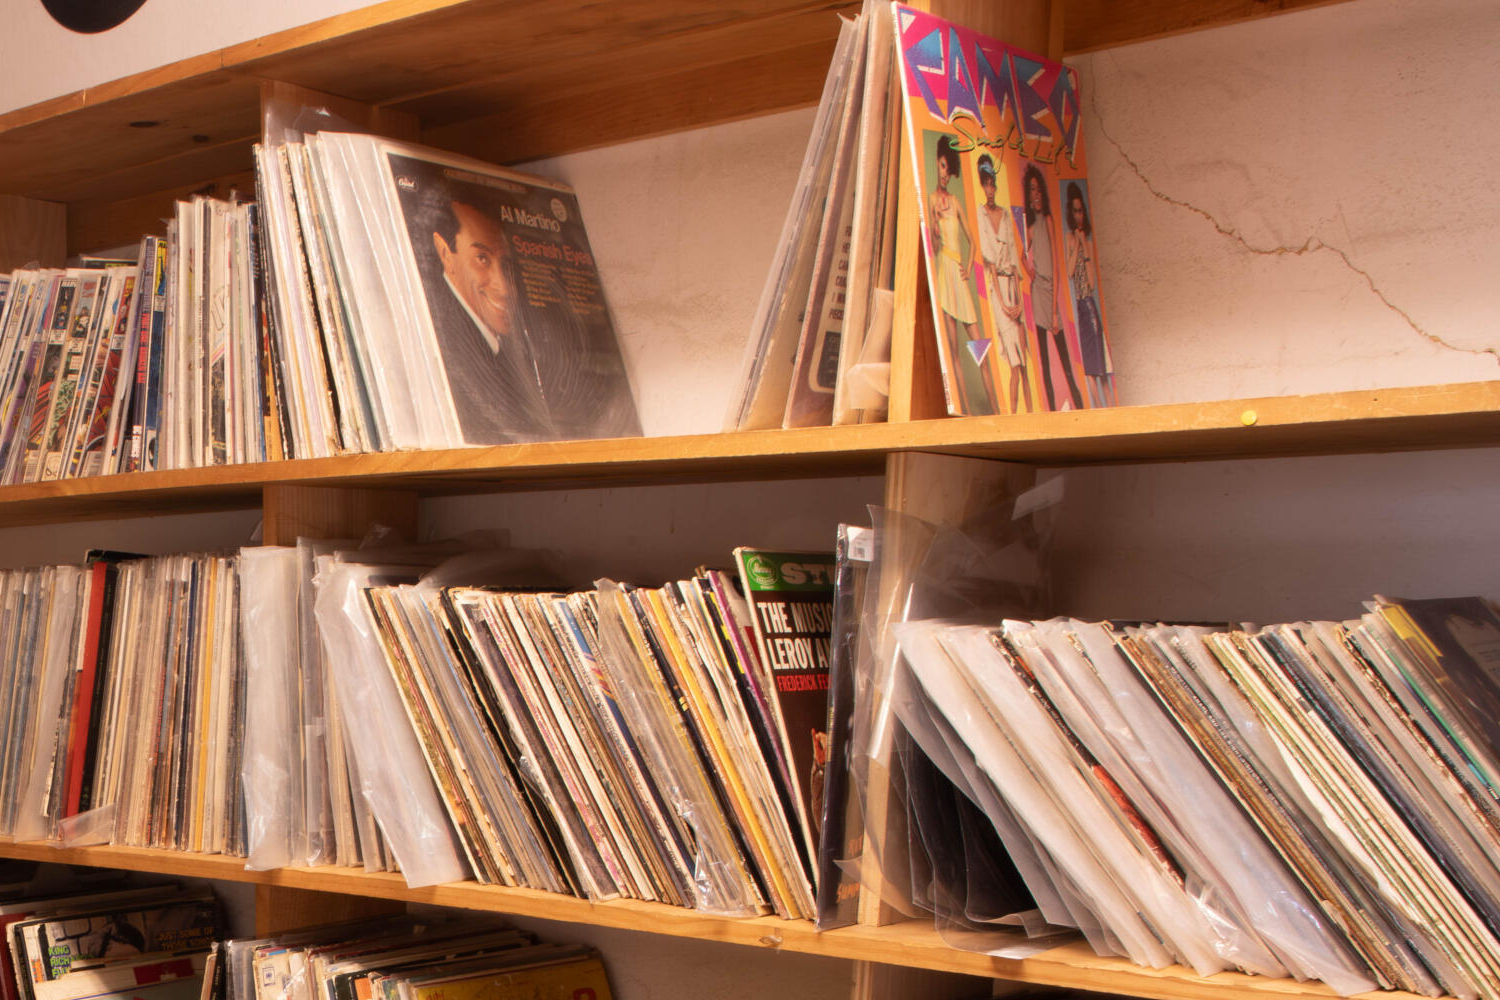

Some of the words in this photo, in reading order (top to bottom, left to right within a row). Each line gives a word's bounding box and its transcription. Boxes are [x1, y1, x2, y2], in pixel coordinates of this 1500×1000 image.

[501, 204, 514, 223] Al
[514, 207, 561, 233] Martino
[512, 234, 562, 260] Spanish
[562, 244, 593, 266] Eyes
[757, 602, 792, 634] THE
[766, 638, 814, 670] LEROY
[776, 674, 816, 692] FREDERICK
[48, 944, 70, 956] KING
